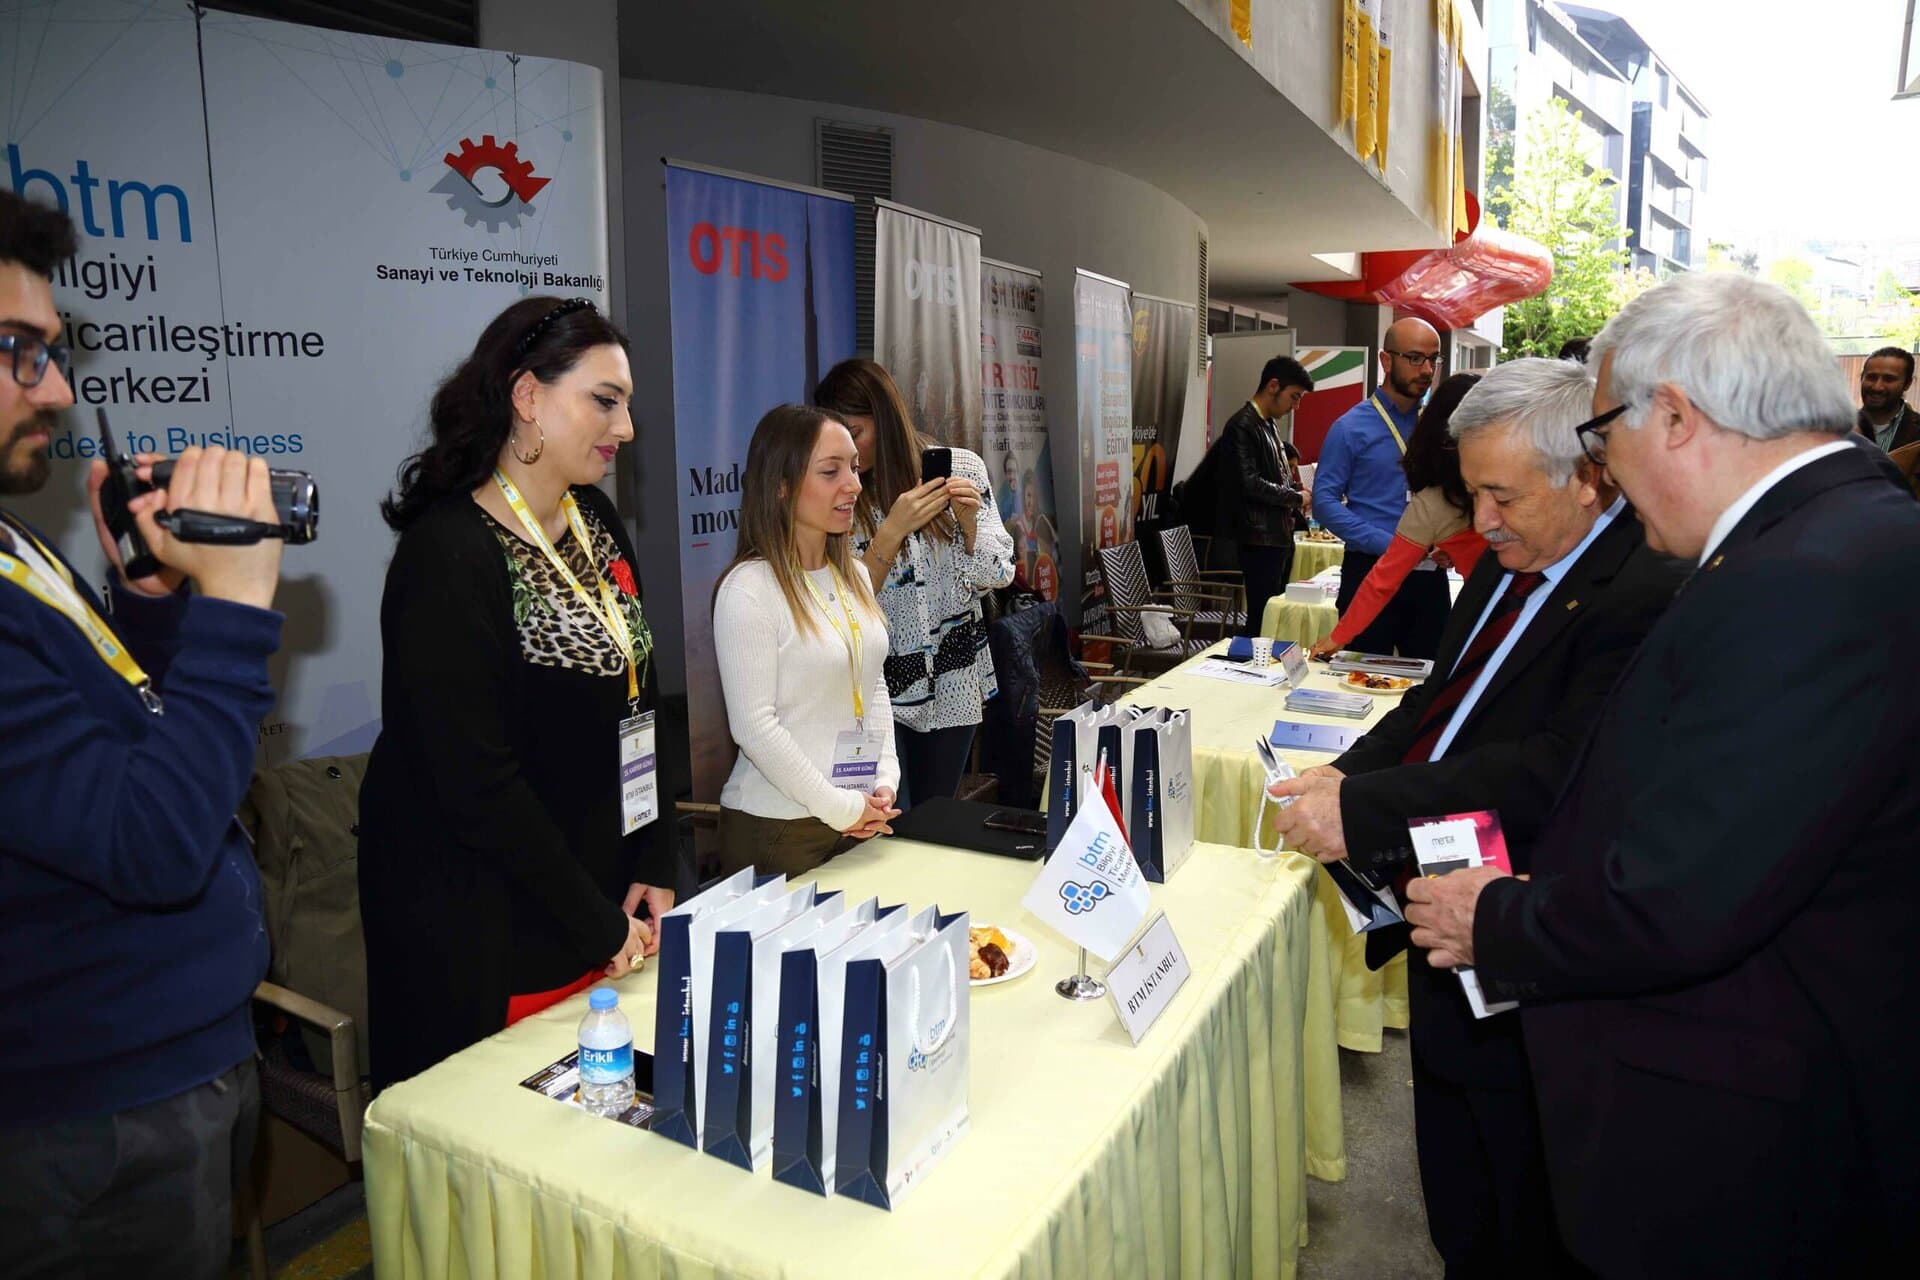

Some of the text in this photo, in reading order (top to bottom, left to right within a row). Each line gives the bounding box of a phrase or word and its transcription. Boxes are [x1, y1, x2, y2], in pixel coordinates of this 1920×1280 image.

[8, 143, 192, 243] btm
[430, 247, 558, 267] Türkiye Cumhuriyeti
[688, 221, 790, 283] OTIS
[49, 252, 157, 301] ilgiyi
[377, 265, 434, 284] Sanayi
[439, 271, 459, 282] ve
[464, 268, 538, 289] Teknoloji
[904, 259, 962, 307] OTIS
[57, 312, 325, 361] icarileştirme
[66, 366, 211, 405] erkezi
[127, 430, 156, 455] to
[167, 426, 304, 455] Business
[1079, 831, 1111, 866] btm
[1096, 846, 1117, 872] Bilgiyi
[1127, 950, 1178, 1016] BTM İSTANBUL
[582, 1049, 614, 1065] Erikli
